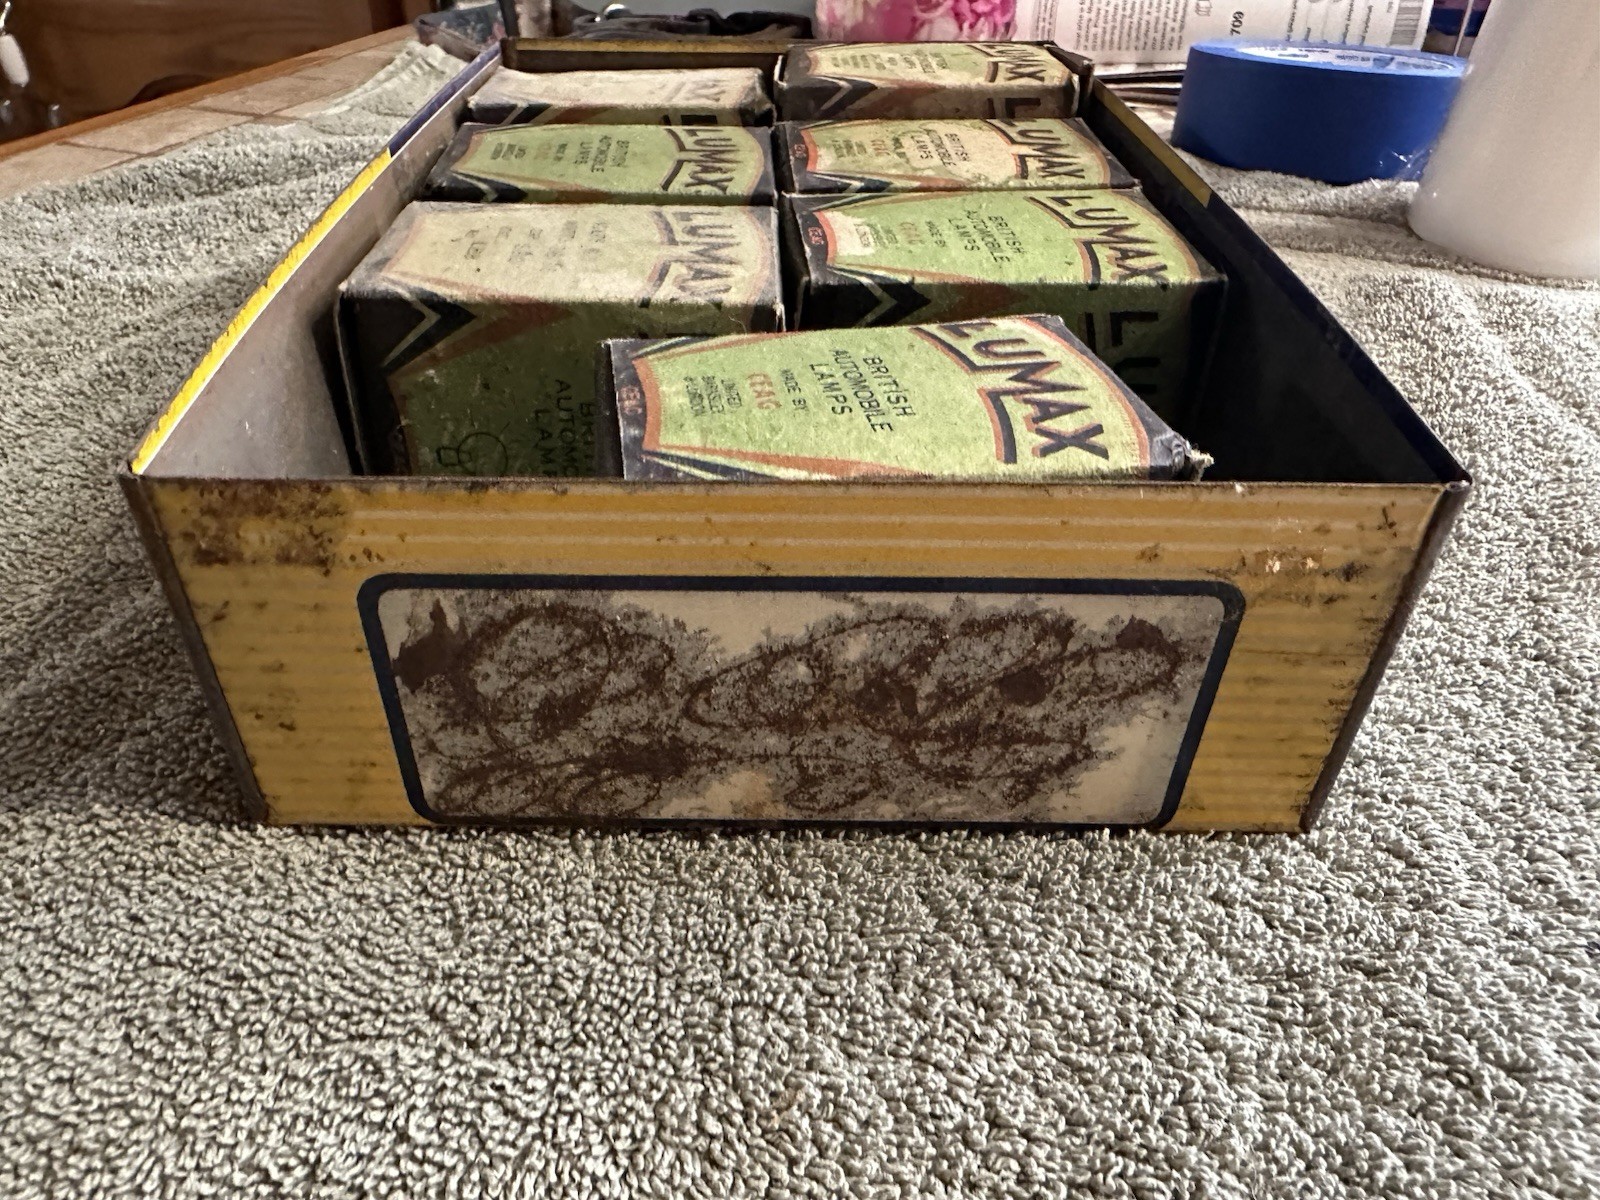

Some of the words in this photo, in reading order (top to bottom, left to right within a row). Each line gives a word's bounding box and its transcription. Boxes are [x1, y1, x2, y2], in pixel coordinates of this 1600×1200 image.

[680, 128, 744, 194] LUMAX
[998, 118, 1086, 179] LUMAX
[1042, 194, 1169, 287] LUMAX
[780, 368, 803, 395] MADE
[792, 397, 809, 413] BY
[809, 362, 853, 417] LAMPS
[829, 348, 894, 433] AUTOMOBILE
[861, 356, 916, 419] BRITISH
[930, 321, 1110, 462] LUMAX
